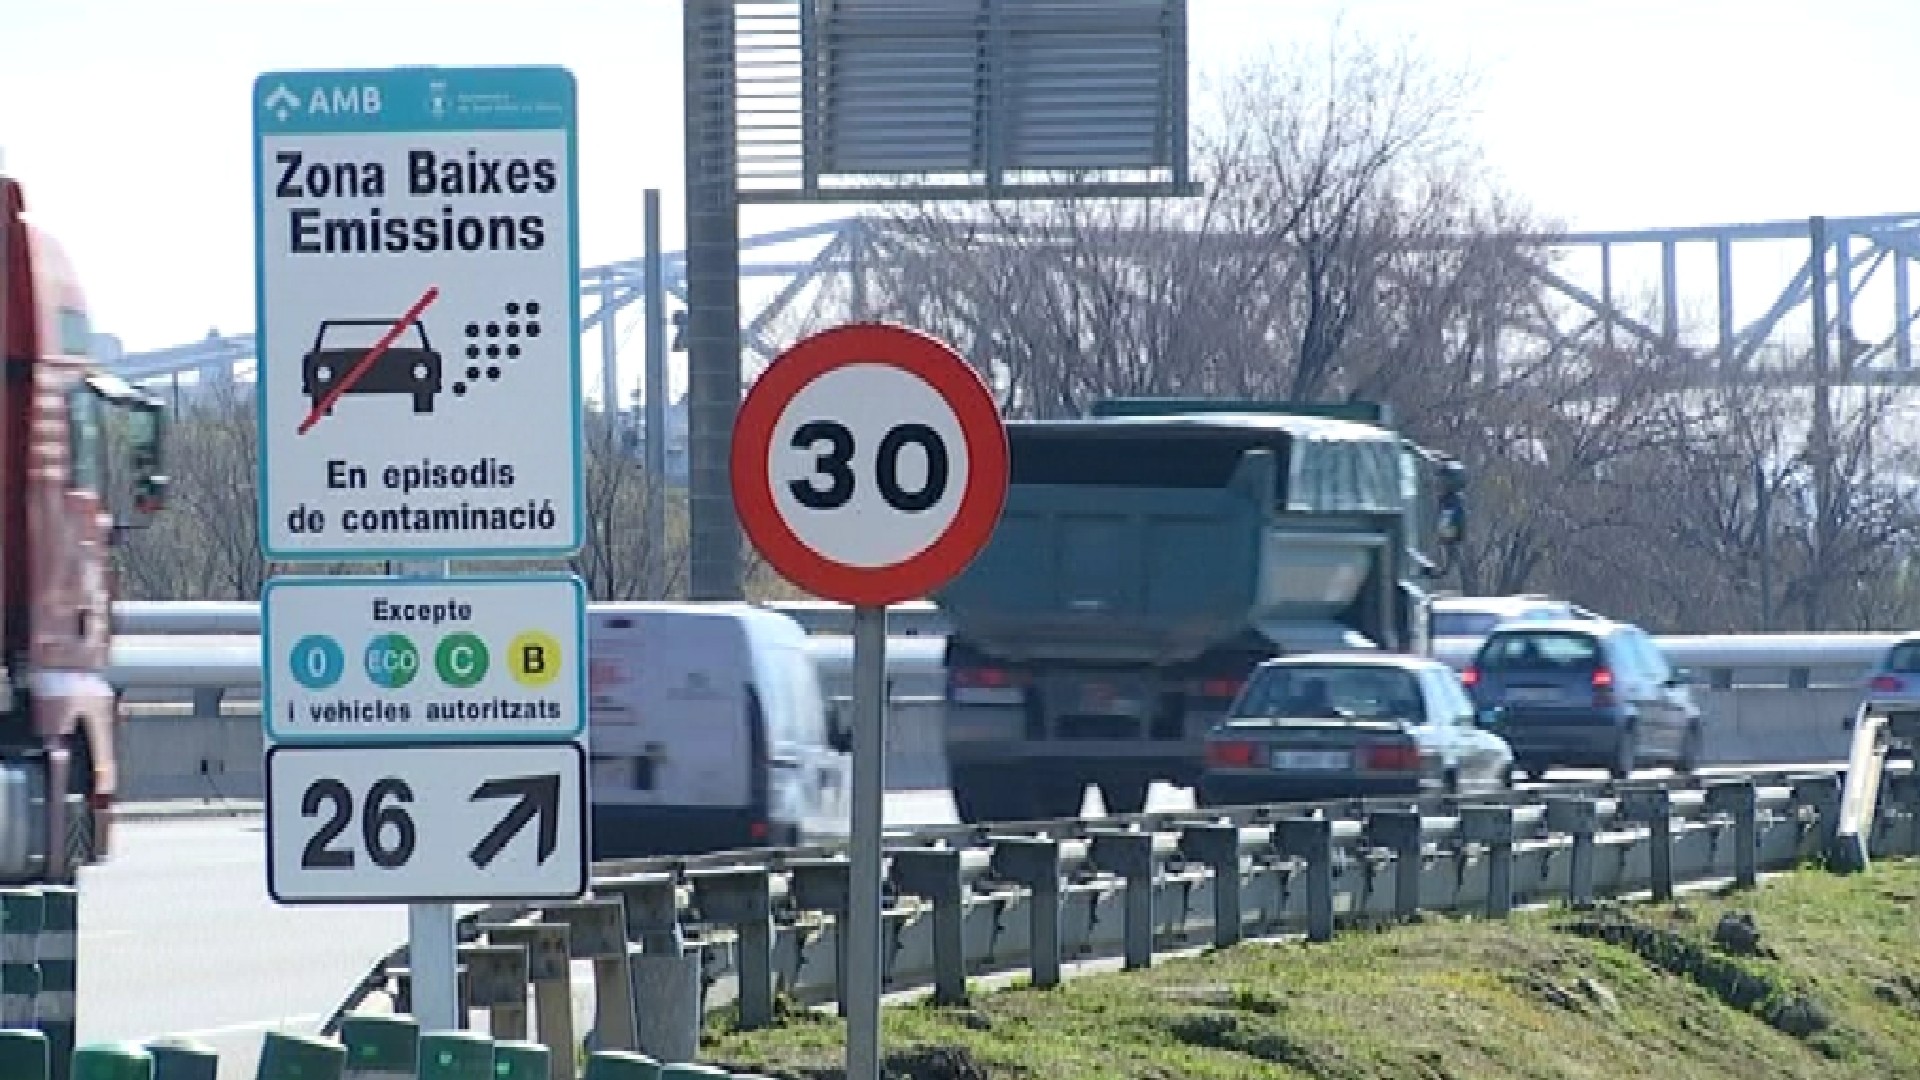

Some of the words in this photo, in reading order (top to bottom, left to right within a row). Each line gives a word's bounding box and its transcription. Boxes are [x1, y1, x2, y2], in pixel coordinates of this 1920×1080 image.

[308, 86, 382, 114] AMB
[275, 150, 386, 198] Zona
[408, 148, 557, 195] Baixes
[290, 206, 545, 253] Emissions
[327, 459, 368, 489] En
[383, 457, 516, 494] episodis
[789, 420, 950, 512] 30
[287, 504, 326, 534] de
[342, 499, 556, 531] contaminació
[372, 599, 472, 624] Excepte
[368, 650, 417, 675] ECO
[450, 646, 475, 676] C
[523, 647, 545, 674] B
[287, 699, 295, 721] i
[426, 696, 561, 720] autoritzats
[301, 778, 416, 868] 26
